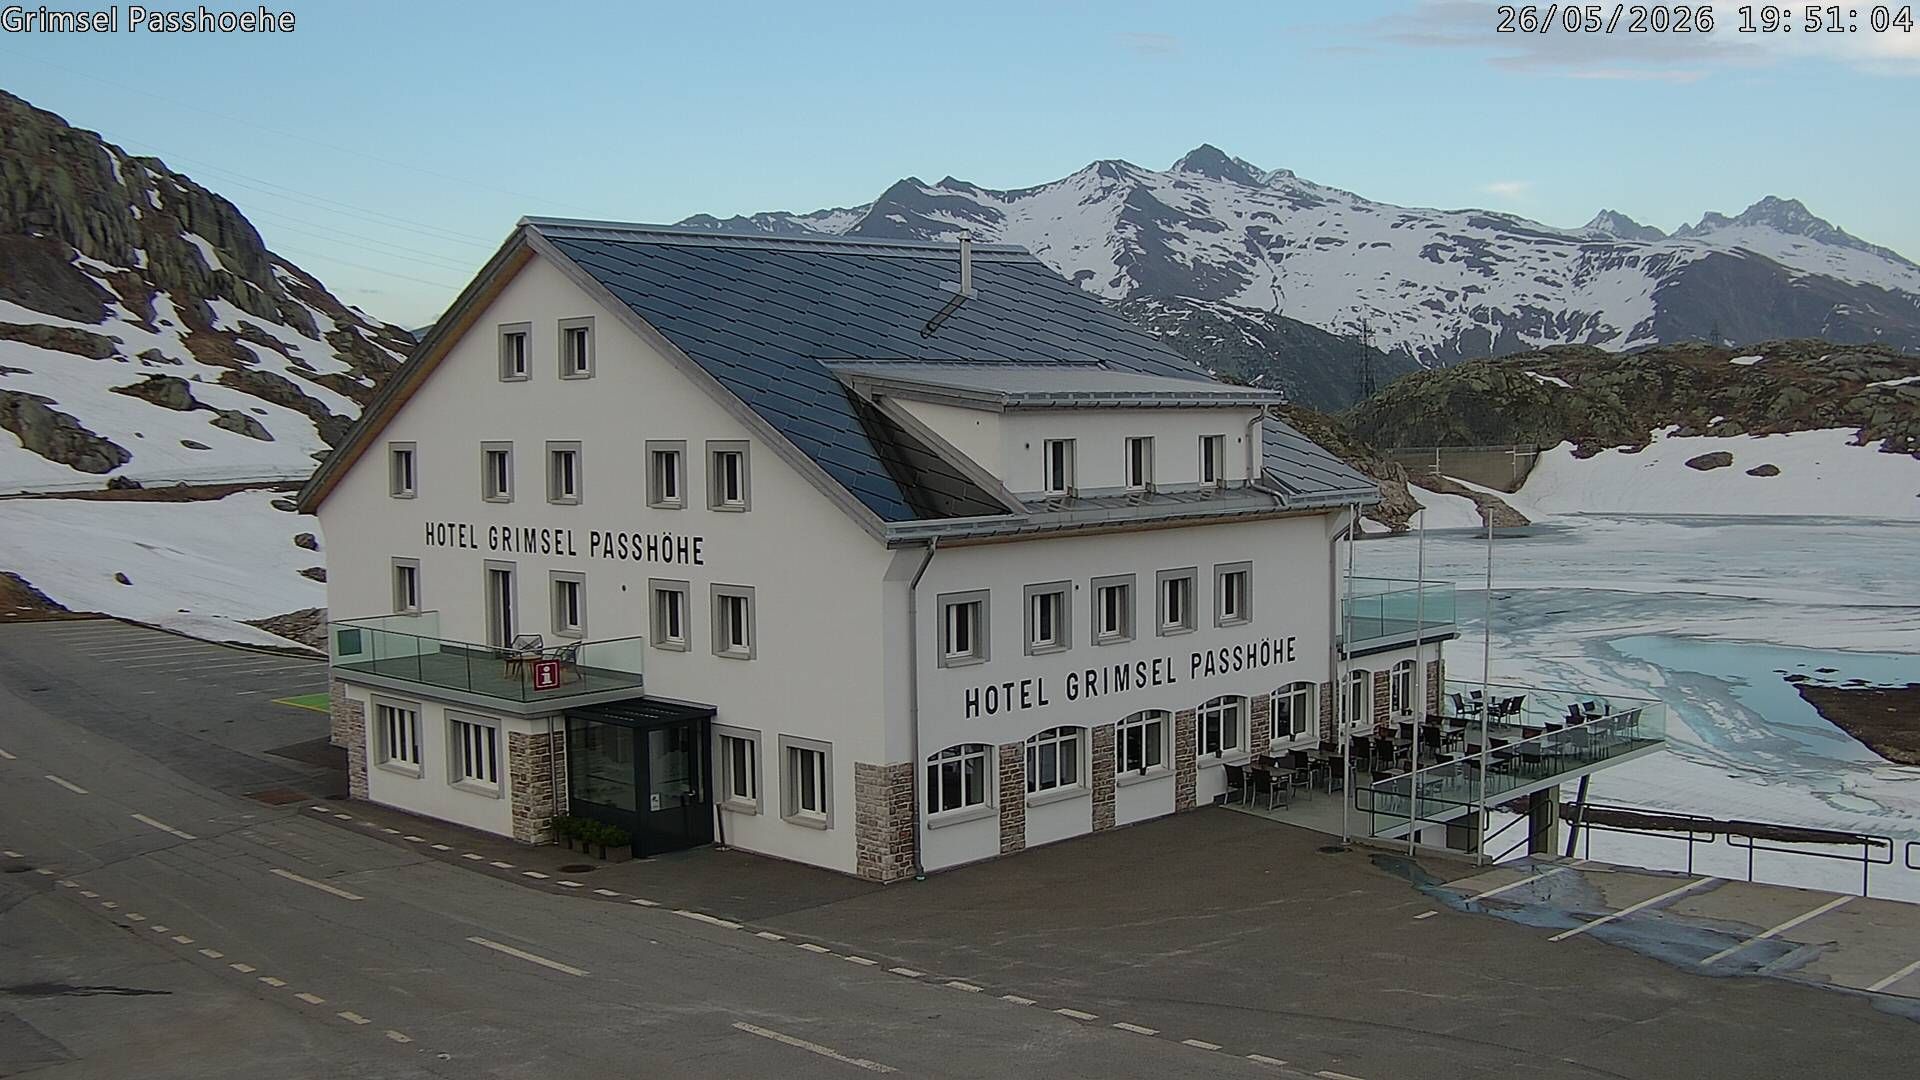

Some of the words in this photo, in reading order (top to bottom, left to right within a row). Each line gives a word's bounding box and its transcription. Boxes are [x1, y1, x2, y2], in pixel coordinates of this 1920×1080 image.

[425, 522, 478, 549] HOTEL
[488, 526, 576, 556] GRIMSEL
[590, 531, 704, 565] PASSHÖHE
[965, 677, 1049, 718] HOTEL
[1066, 657, 1176, 700] GRIMSEL
[1191, 636, 1296, 679] PASSHÖHE
